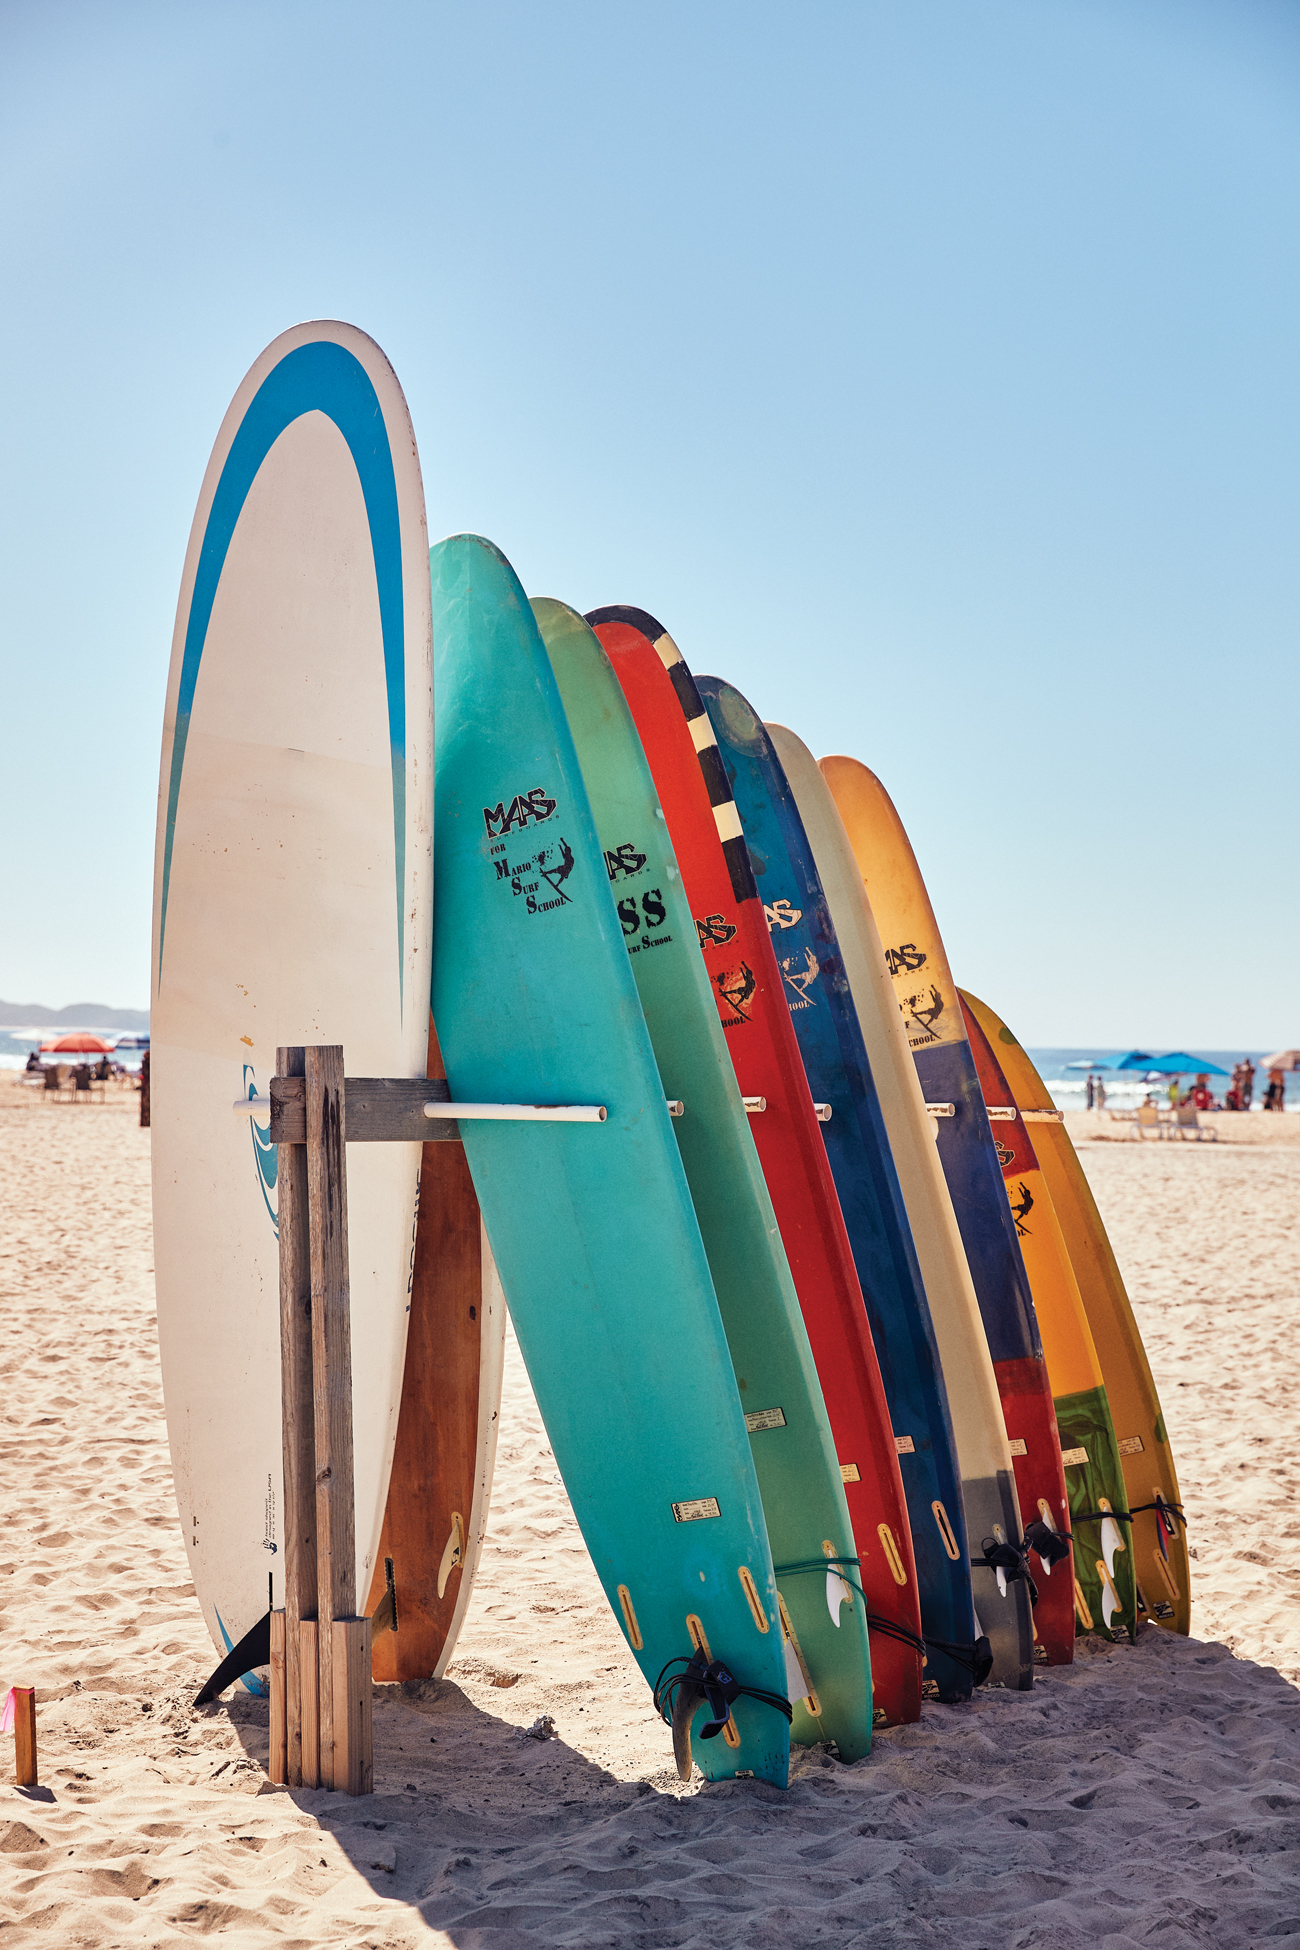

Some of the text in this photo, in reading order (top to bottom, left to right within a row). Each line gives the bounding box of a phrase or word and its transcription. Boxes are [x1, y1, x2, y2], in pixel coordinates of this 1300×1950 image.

[490, 843, 506, 855] FOR
[493, 858, 532, 880] MARIO
[511, 876, 540, 896] SURF
[526, 895, 567, 914] SCHOOL
[641, 934, 673, 950] SCHOOL
